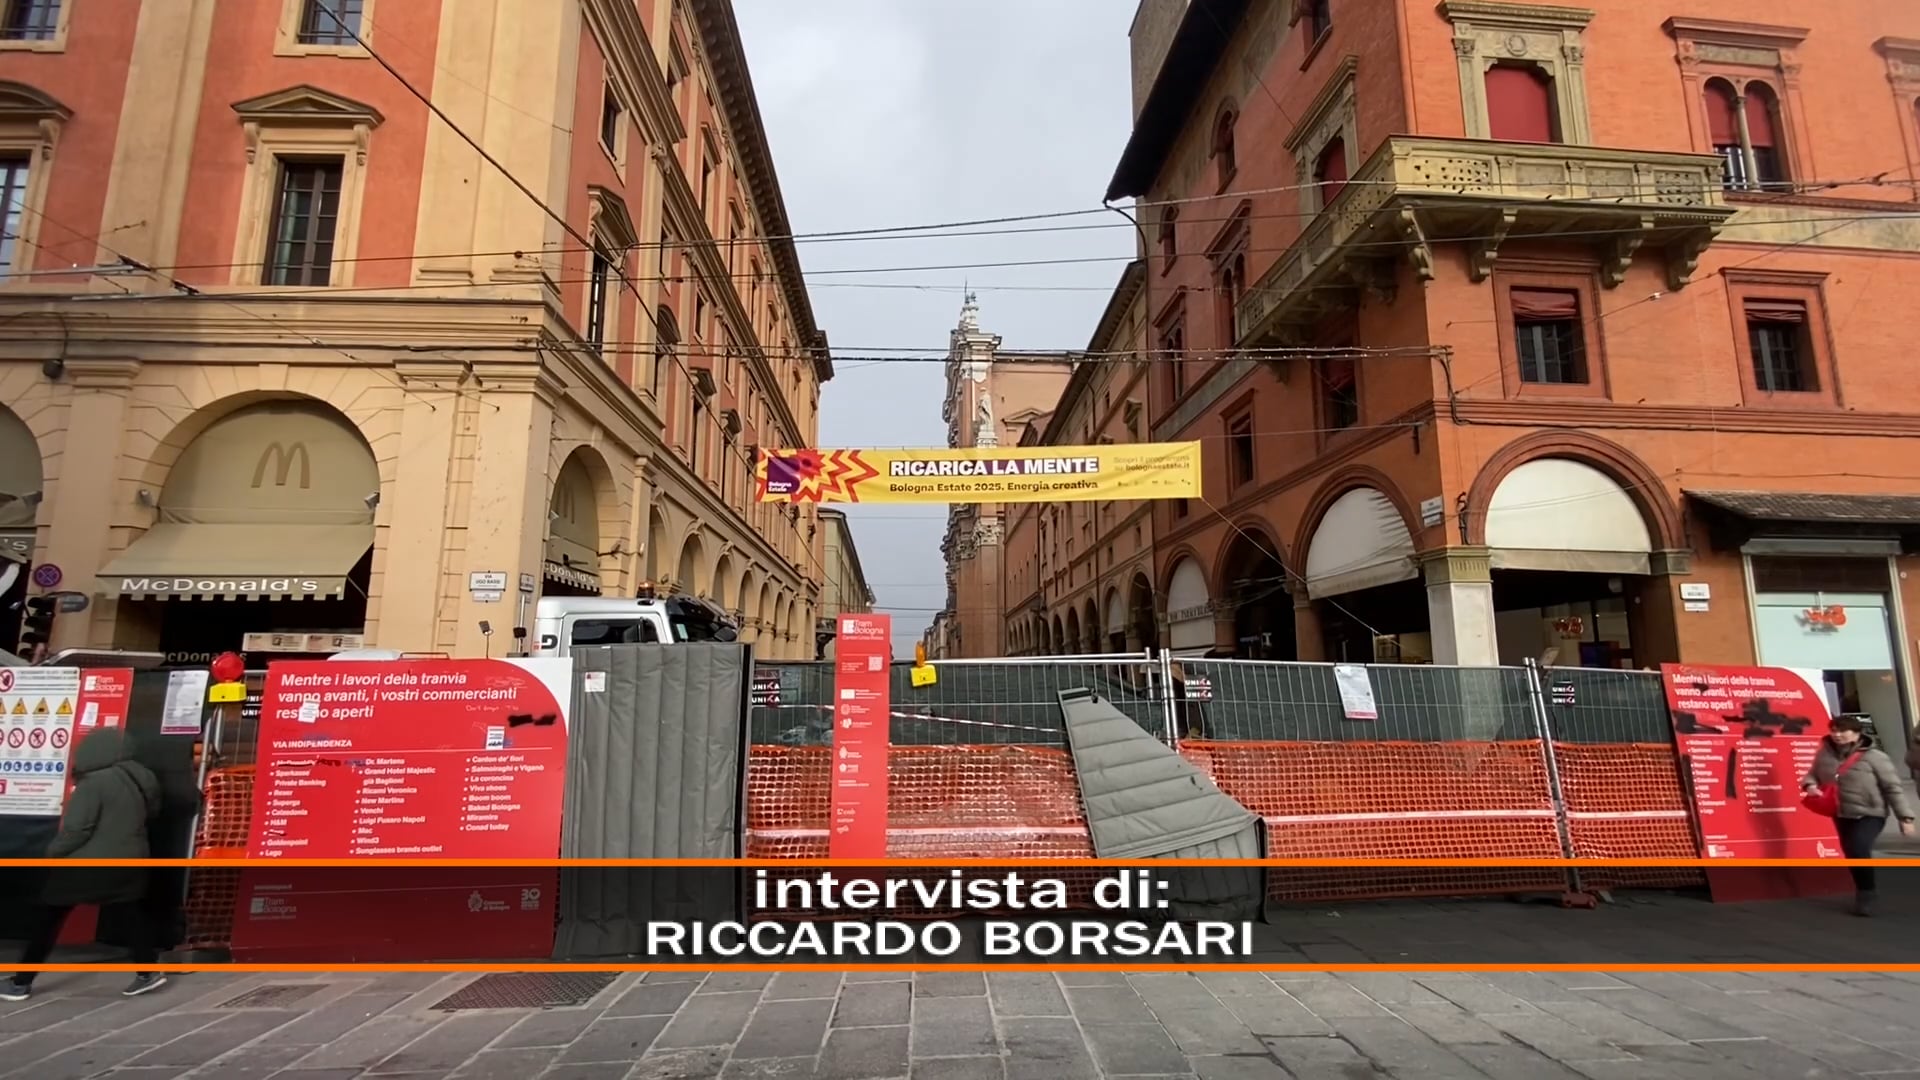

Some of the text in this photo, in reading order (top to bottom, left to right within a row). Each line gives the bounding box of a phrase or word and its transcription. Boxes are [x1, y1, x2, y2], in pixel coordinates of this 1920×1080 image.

[891, 457, 1098, 476] RICARICA LA MENTE
[890, 480, 1098, 493] Bologna Estate 2025. Energia creativa
[121, 578, 319, 591] McDonald's
[854, 619, 873, 628] Tram
[854, 627, 884, 637] Bologna
[281, 672, 467, 687] Mentre i lavori della tranvia
[1672, 673, 1703, 684] Mentre
[1707, 674, 1729, 685] lavori
[1730, 674, 1749, 685] della
[1749, 676, 1775, 686] tranvia
[278, 692, 321, 703] vanno
[324, 689, 370, 703] avanti,
[373, 689, 378, 701] i
[381, 688, 419, 701] vostri
[422, 687, 518, 700] commercianti
[1675, 687, 1701, 696] vanno
[1733, 687, 1754, 698] vostri
[1754, 689, 1804, 699] commercianti
[1678, 699, 1734, 712] restano aperti
[276, 705, 329, 719] reso
[332, 705, 375, 721] aperti
[272, 739, 352, 749] VIA INDIPENDENZA
